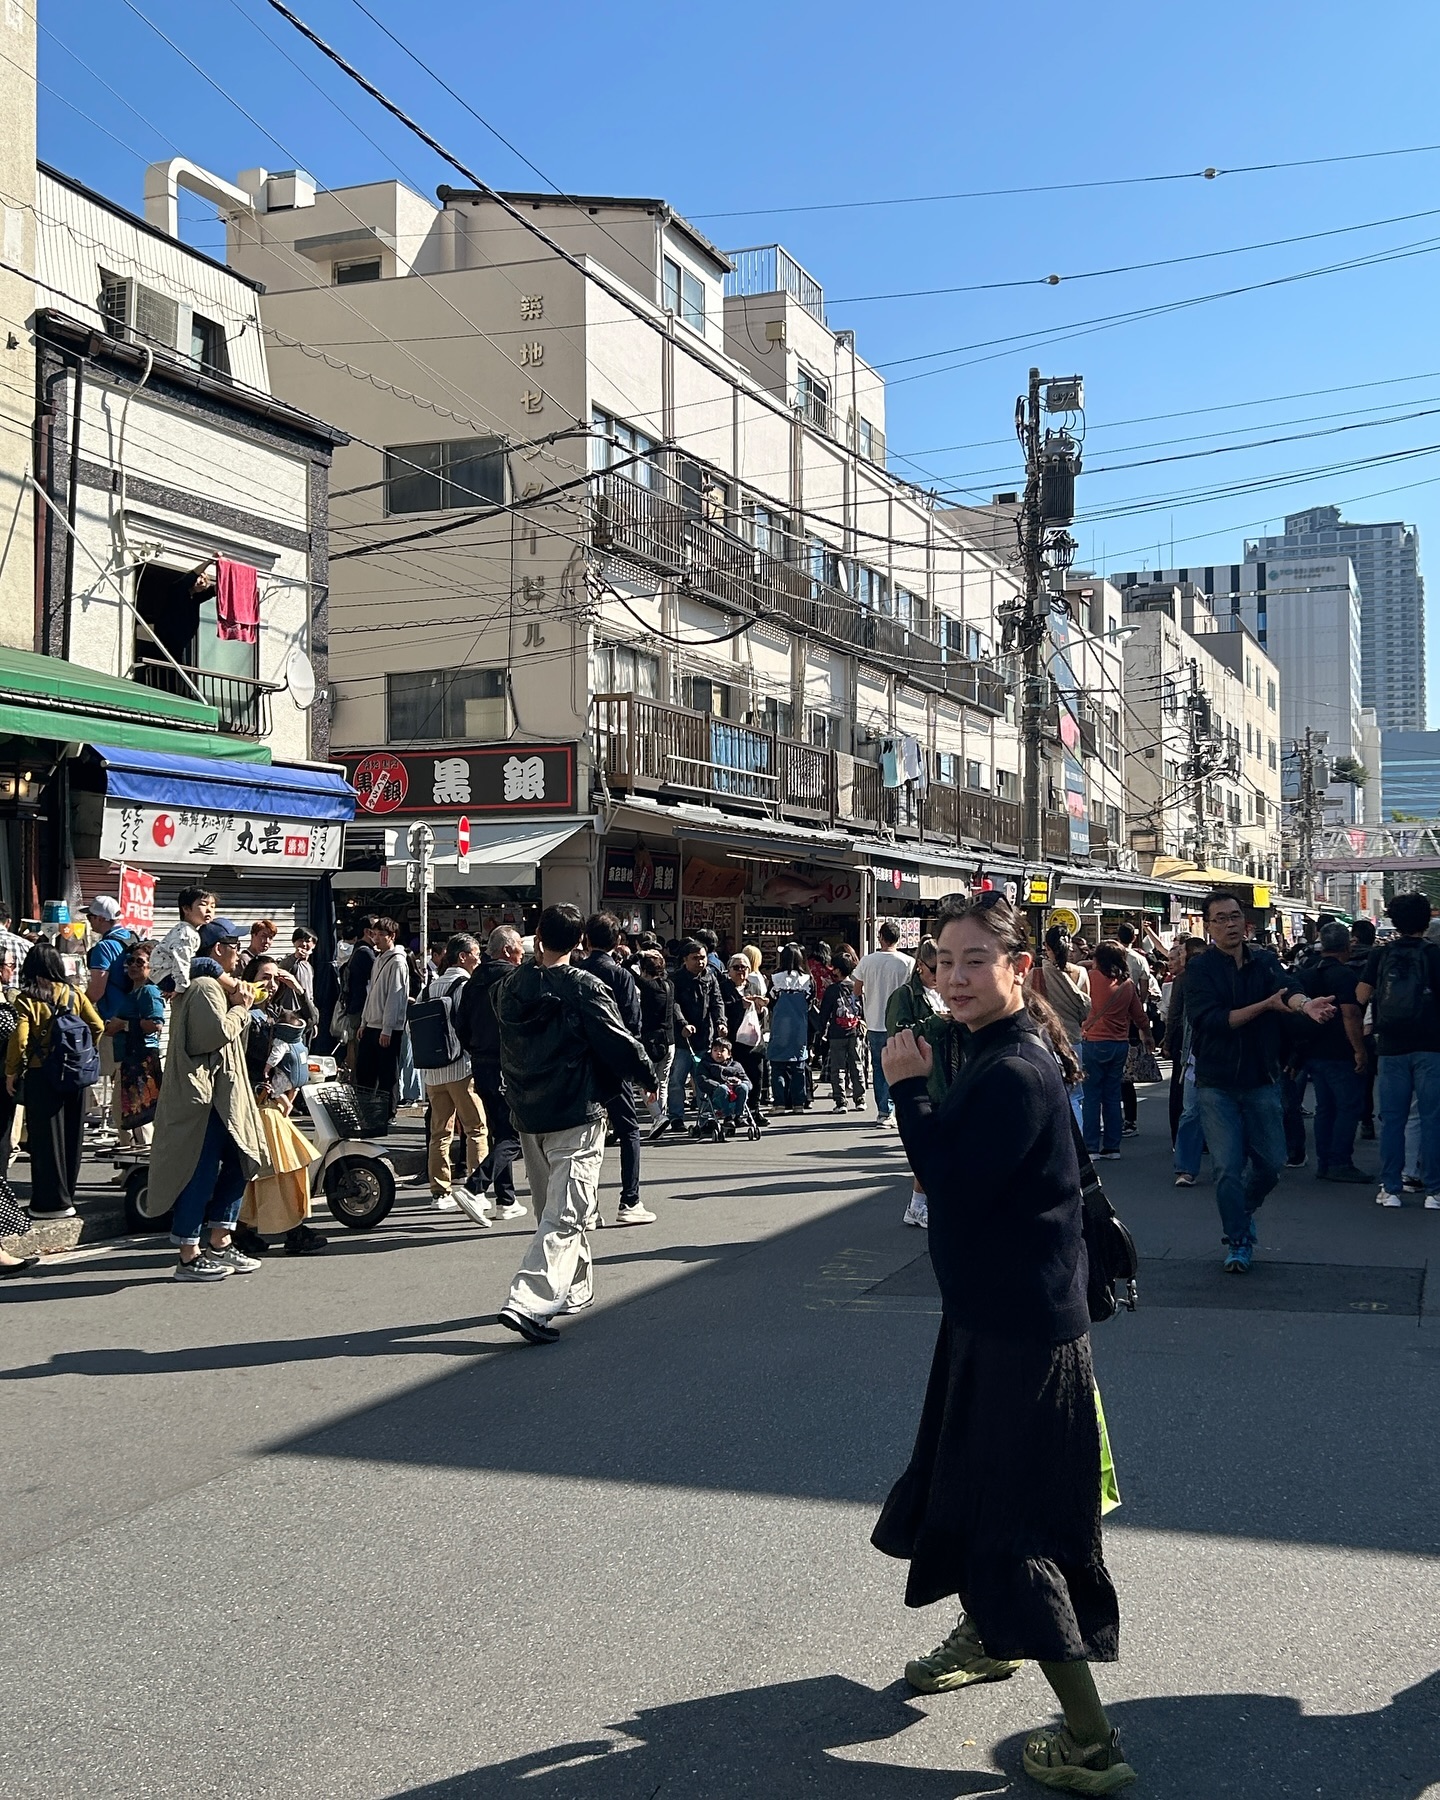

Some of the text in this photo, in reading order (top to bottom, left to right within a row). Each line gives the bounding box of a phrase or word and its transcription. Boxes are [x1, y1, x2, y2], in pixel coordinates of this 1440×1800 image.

[433, 755, 545, 804] 黒銀
[234, 820, 284, 855] 丸豊
[127, 882, 154, 906] TAX
[126, 902, 154, 921] FREE
